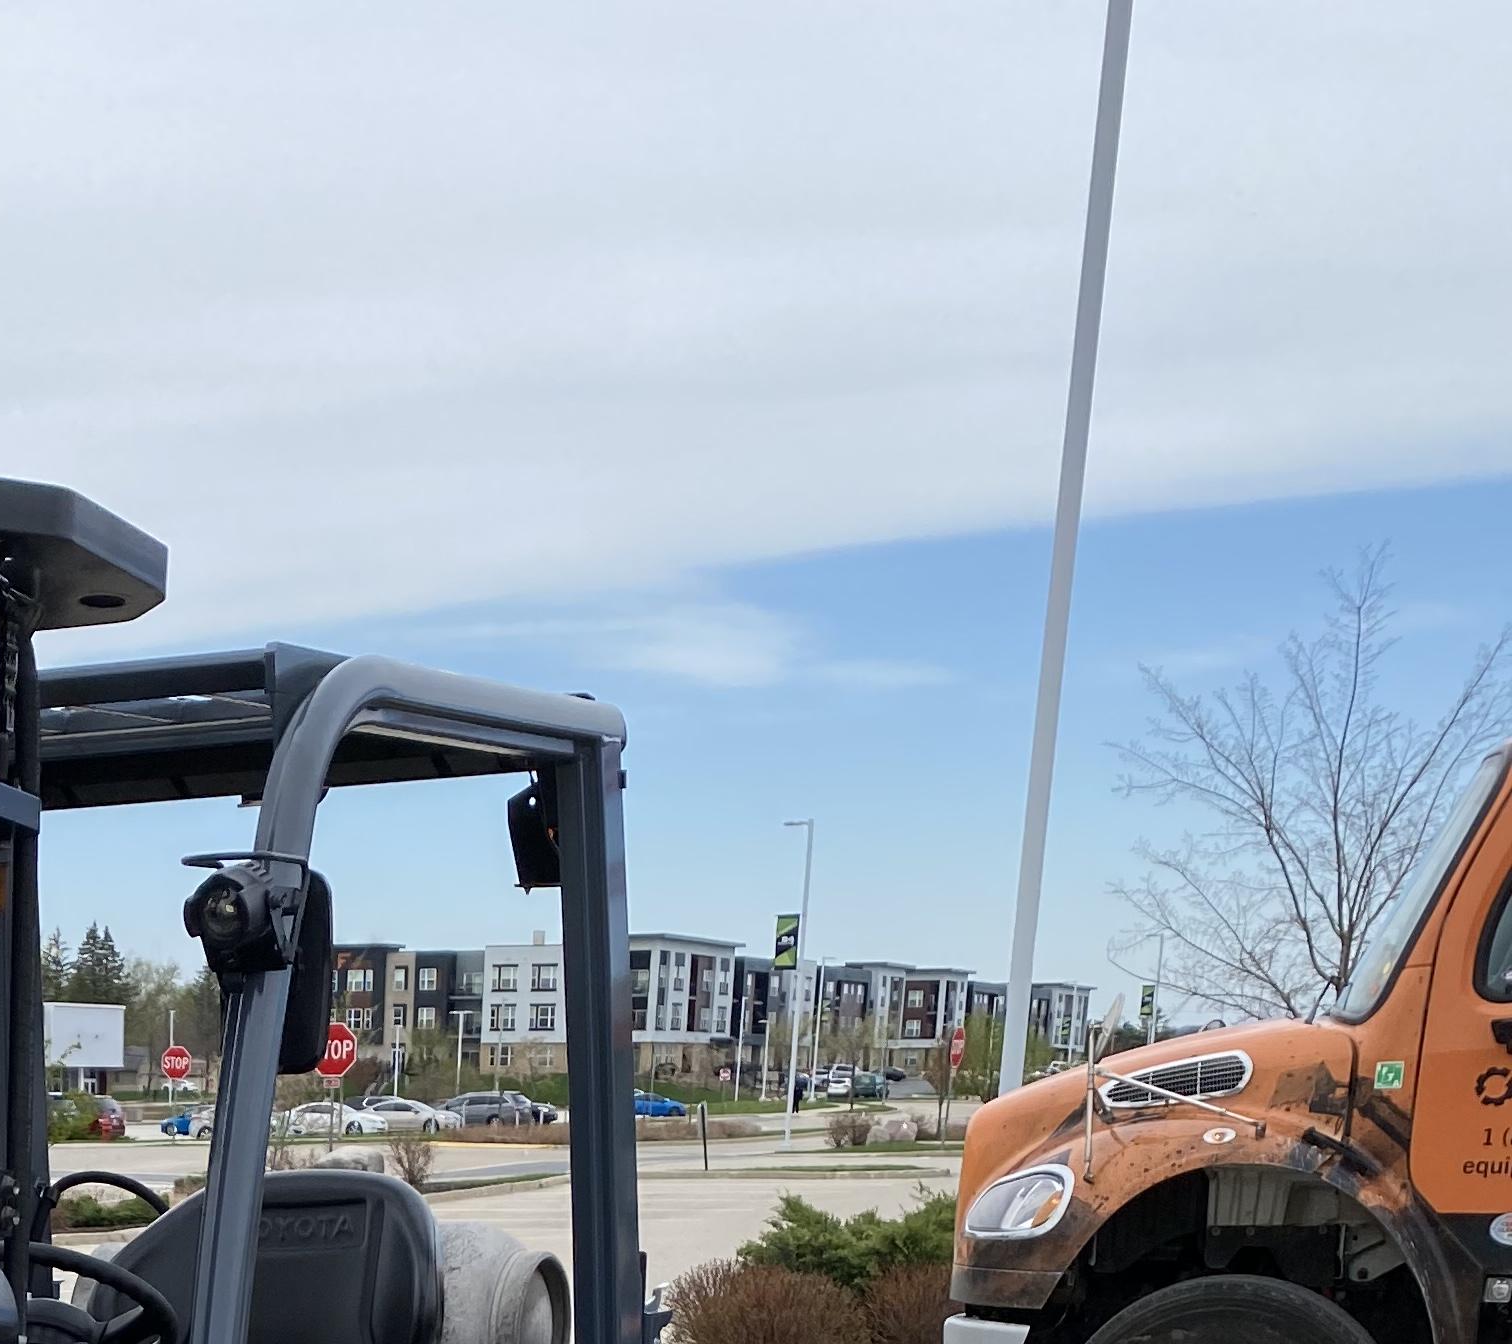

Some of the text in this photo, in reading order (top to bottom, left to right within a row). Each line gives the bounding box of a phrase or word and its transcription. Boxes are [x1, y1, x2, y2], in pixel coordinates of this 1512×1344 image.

[323, 1040, 354, 1060] TOP
[163, 1056, 189, 1070] STOP
[1482, 1127, 1493, 1146] 1
[1462, 1155, 1512, 1178] equi
[259, 1215, 354, 1240] OYOTA
